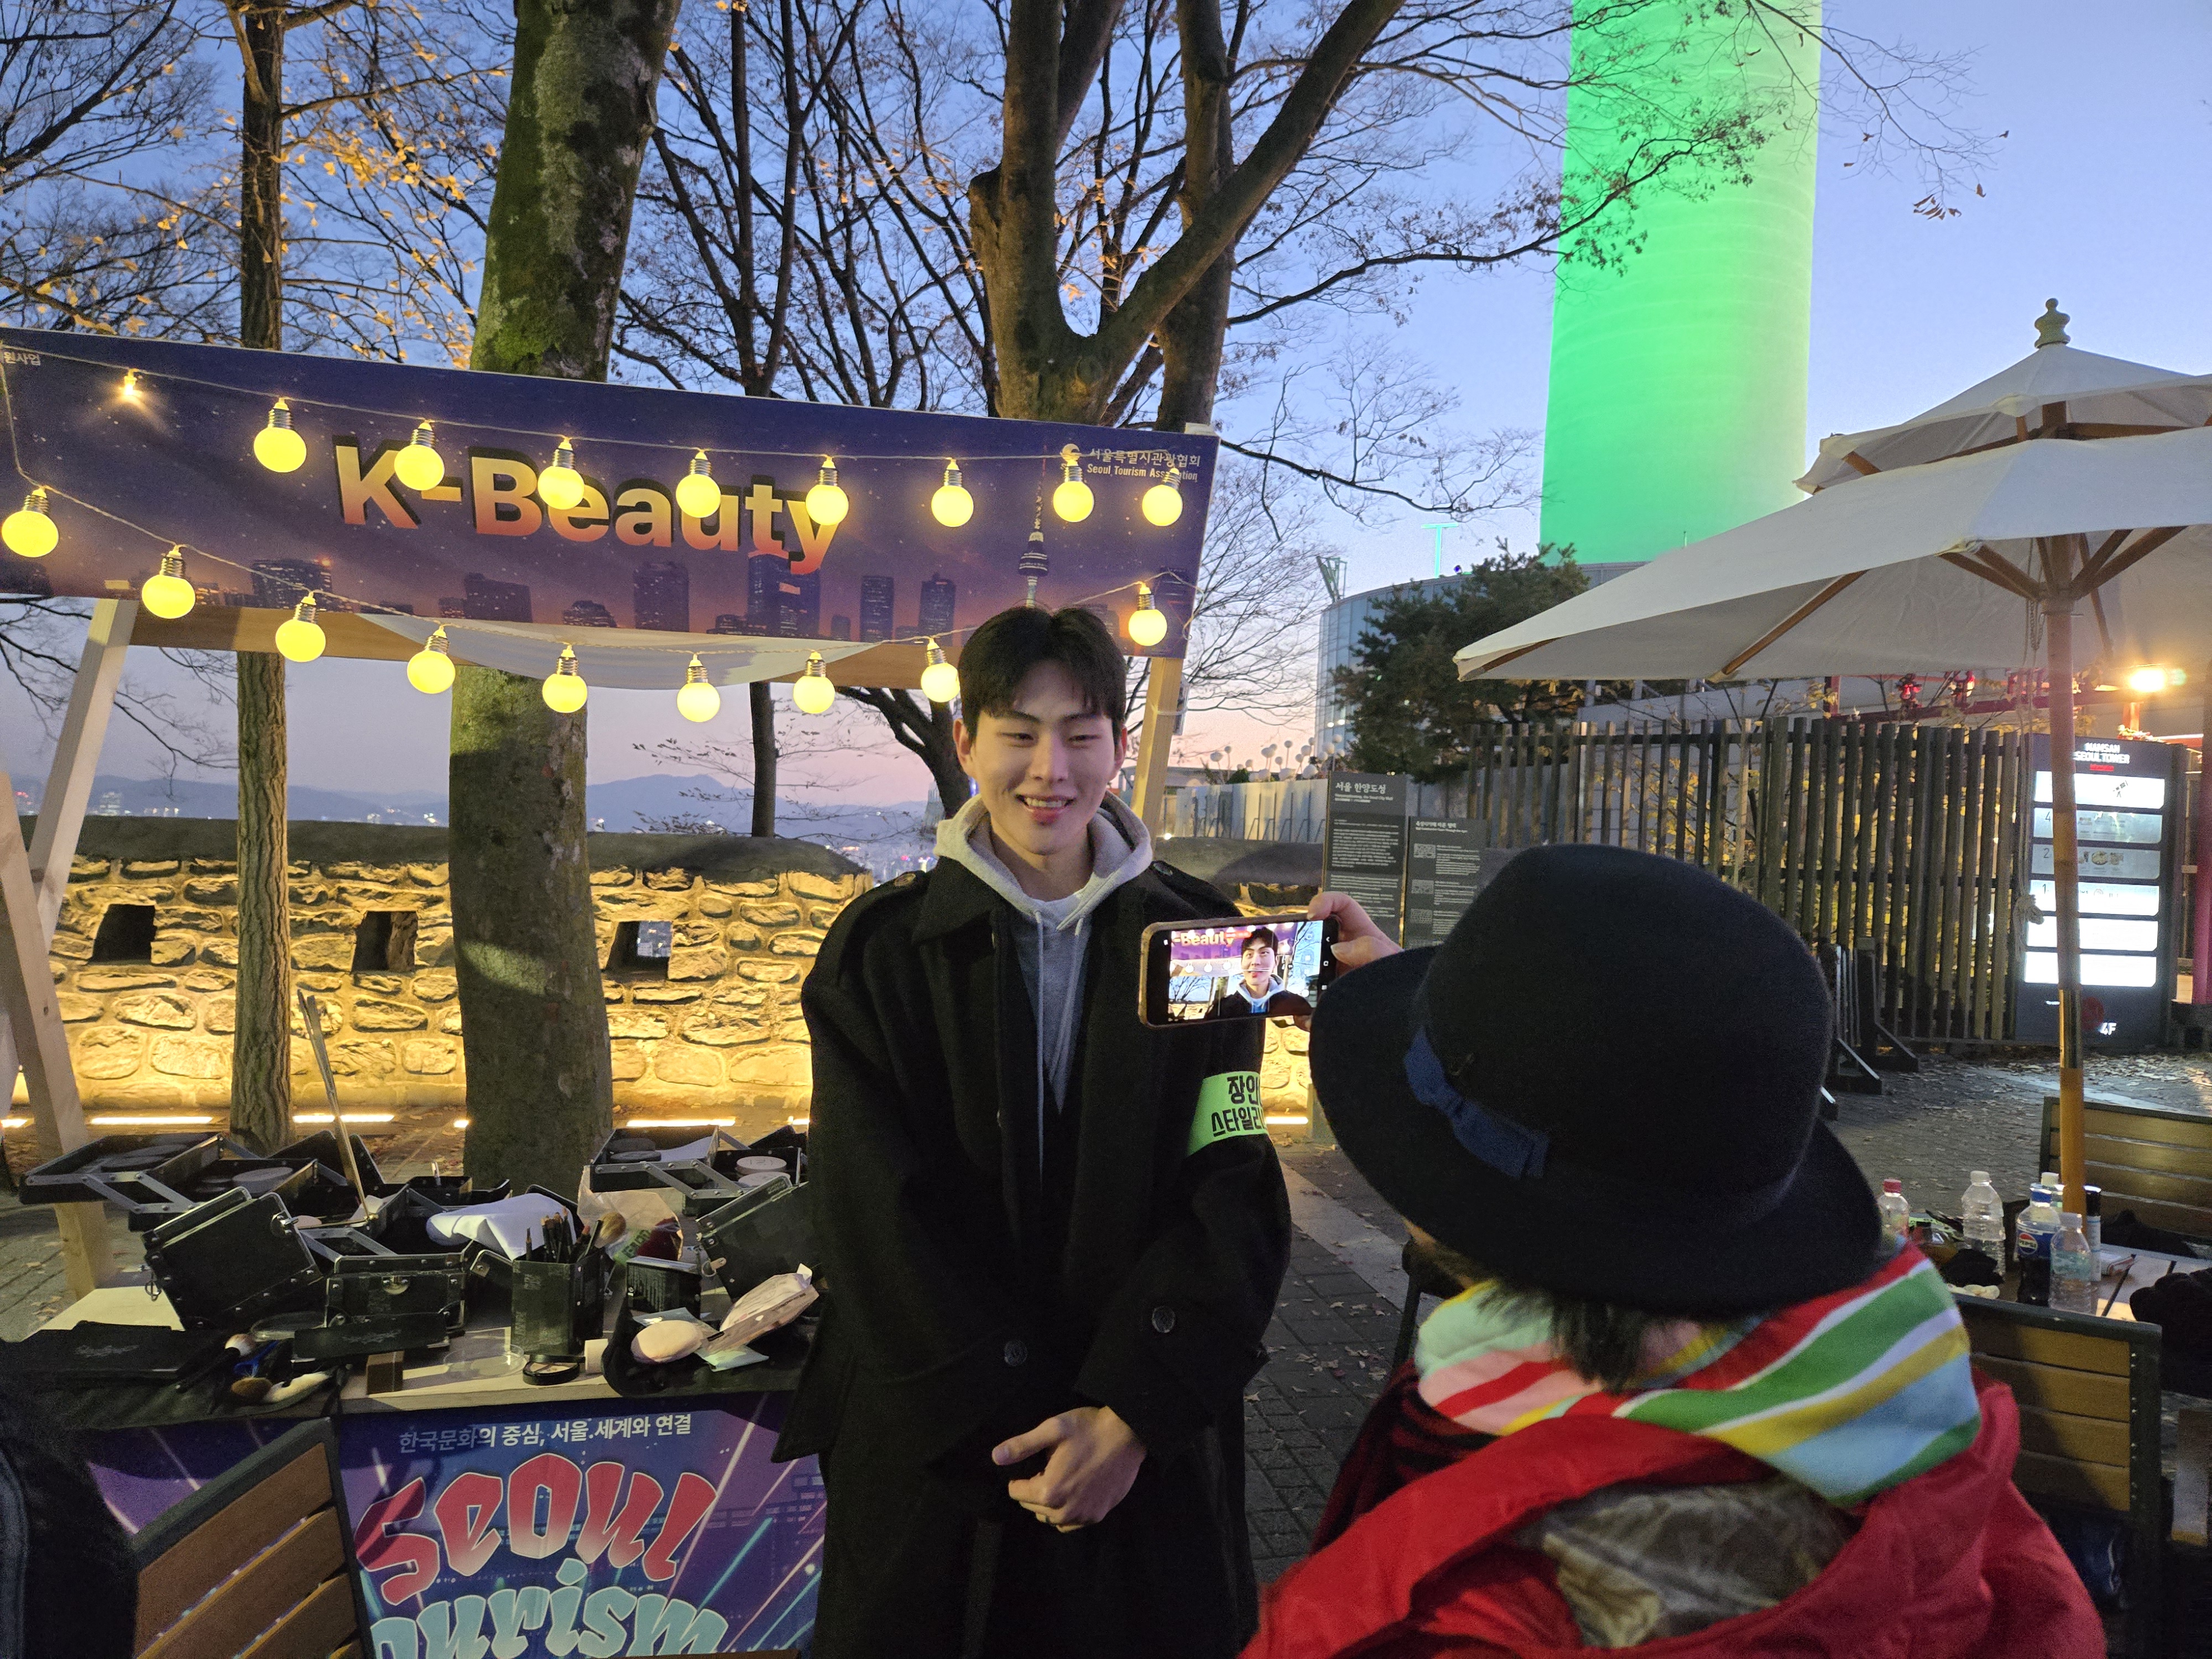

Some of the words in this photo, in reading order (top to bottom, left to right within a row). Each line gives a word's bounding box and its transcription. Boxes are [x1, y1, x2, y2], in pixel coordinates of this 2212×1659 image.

[3, 352, 41, 366] 원사업
[1089, 448, 1201, 468] 서울특별시관광협회
[1087, 463, 1111, 474] Seoul
[1114, 466, 1146, 477] Tourism
[1150, 468, 1198, 481] Asstion
[333, 440, 844, 575] K-Beauty
[2084, 742, 2120, 753] NAMSAN
[2073, 751, 2101, 762] SEOUL
[2100, 753, 2130, 764] TOWER
[1335, 781, 1352, 792] 서울
[1354, 782, 1386, 795] 한양도성
[1172, 931, 1234, 948] -Beauty
[2100, 1022, 2117, 1035] 4F
[1211, 1107, 1265, 1137] 스타일리
[399, 1426, 495, 1453] 한국문화의
[502, 1423, 545, 1447] 중심,
[655, 1414, 691, 1436] 연결
[369, 1558, 728, 1659] ourism
